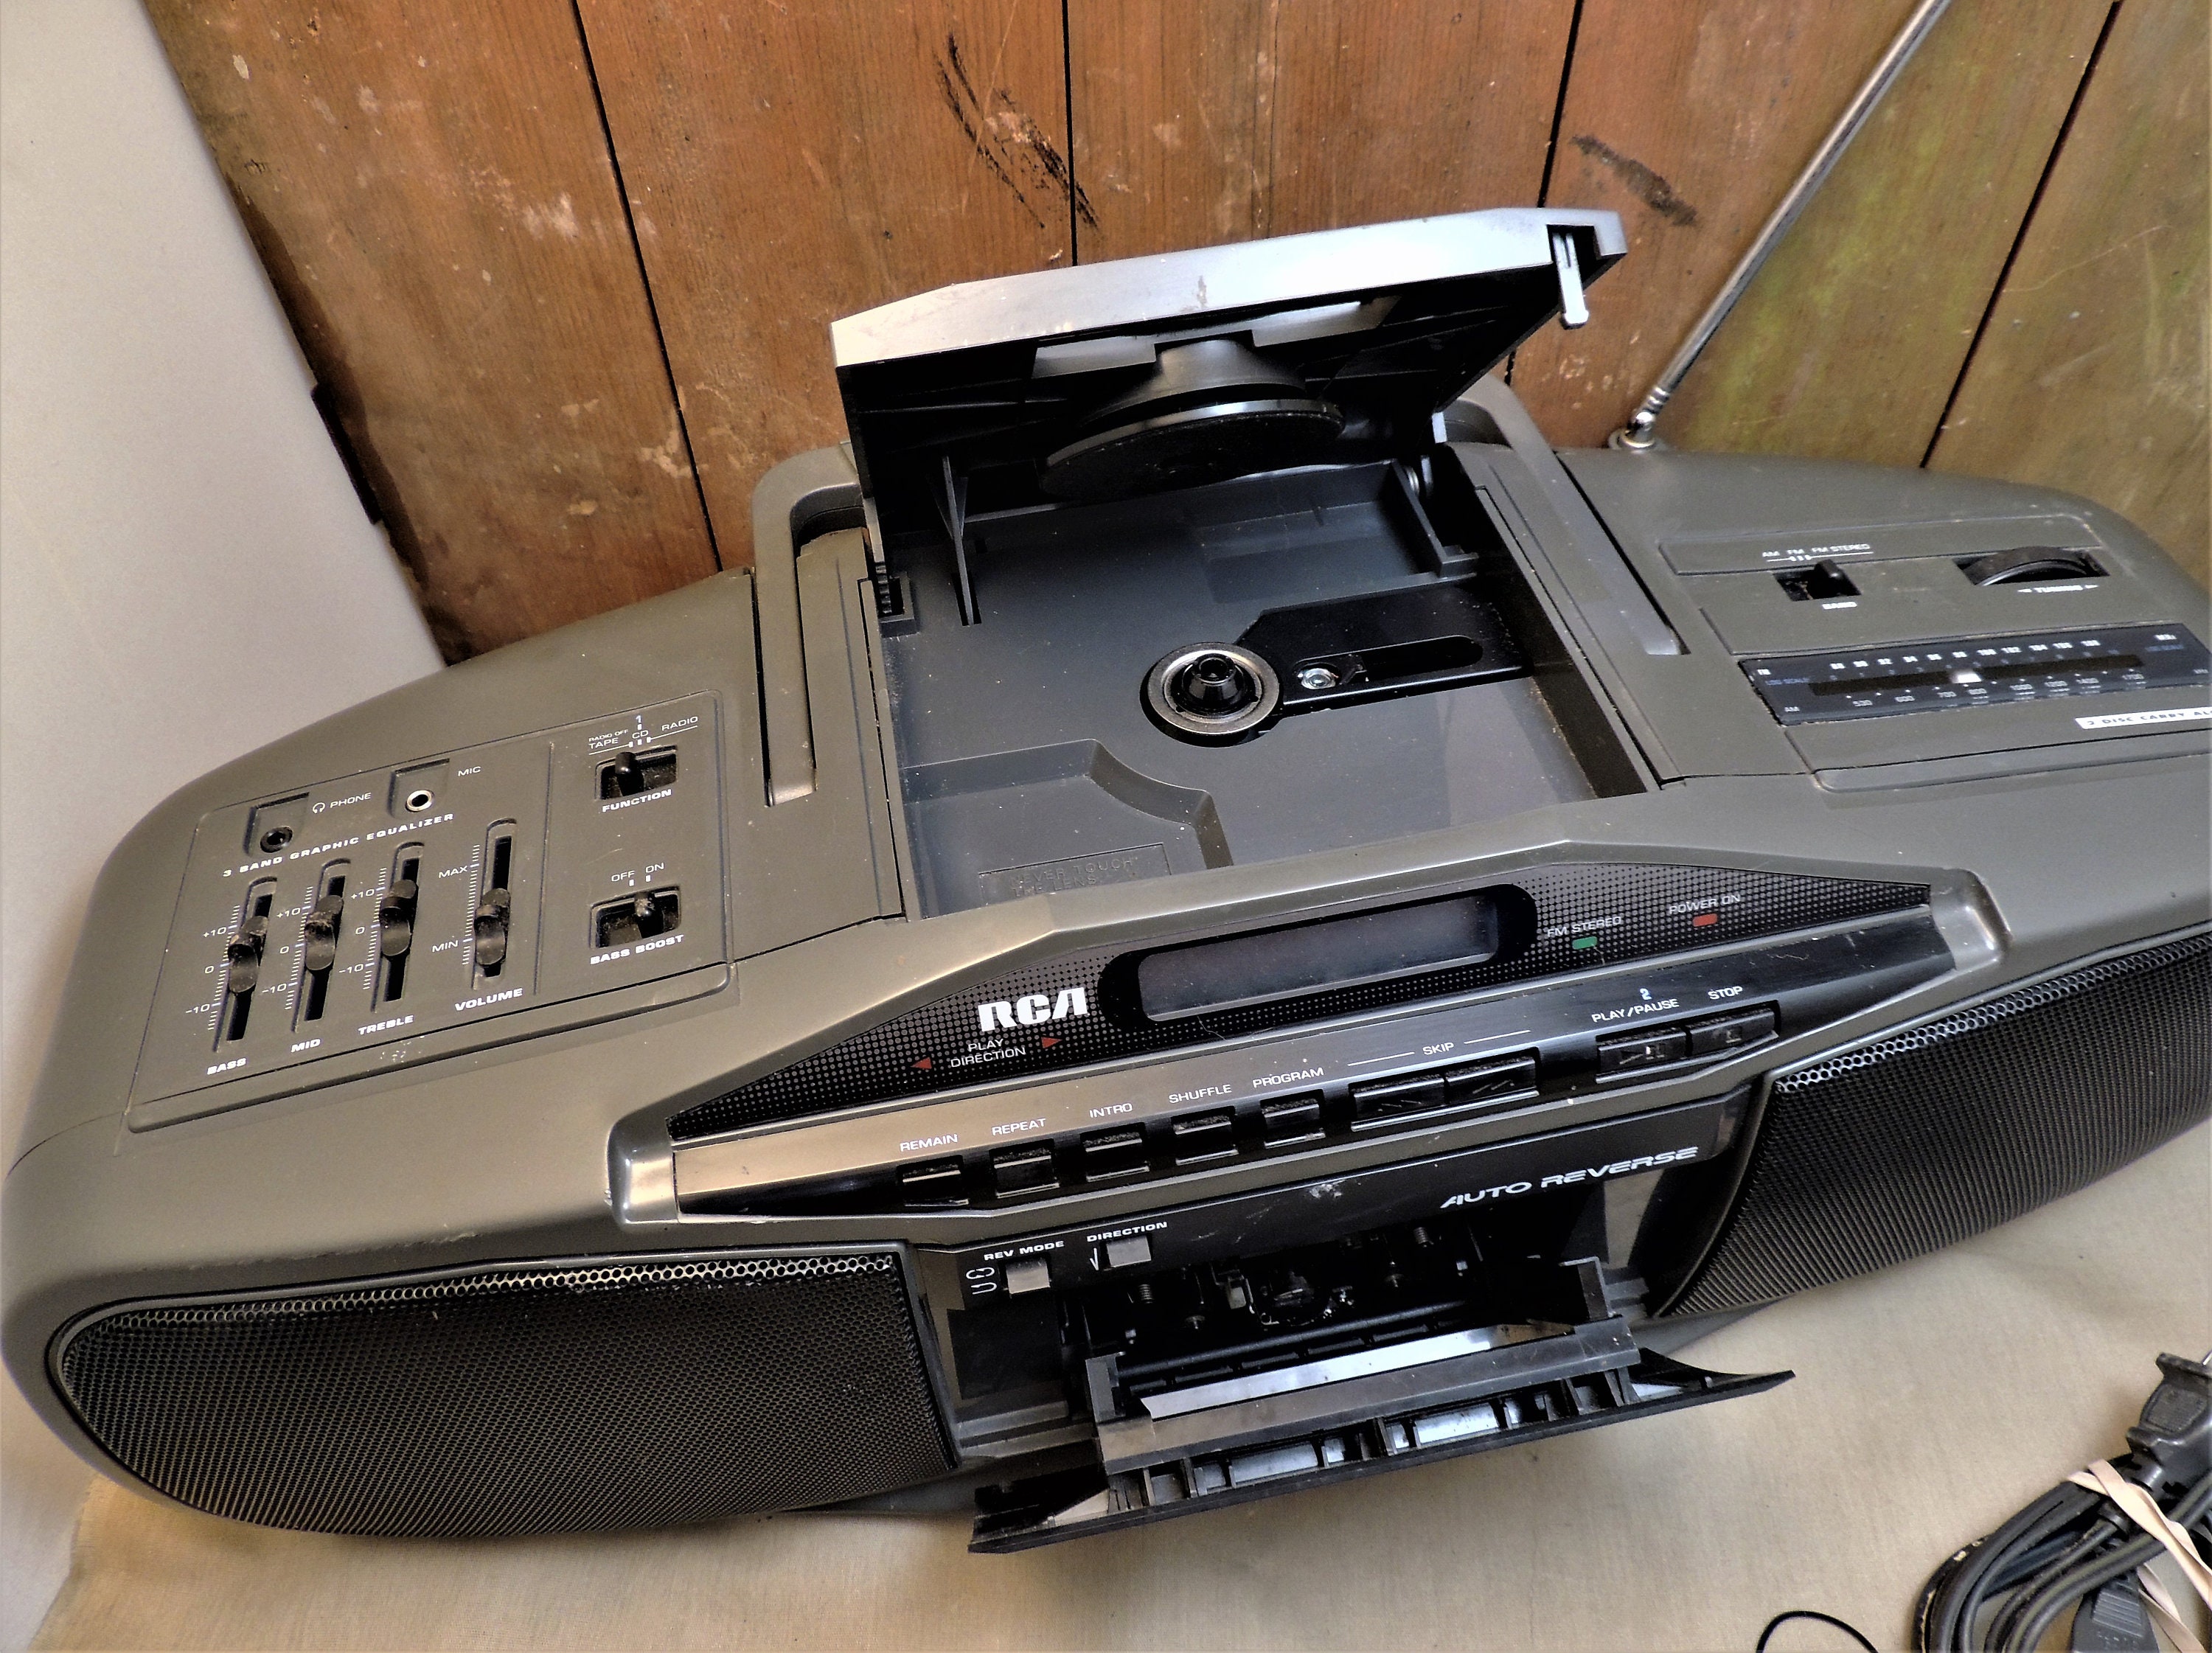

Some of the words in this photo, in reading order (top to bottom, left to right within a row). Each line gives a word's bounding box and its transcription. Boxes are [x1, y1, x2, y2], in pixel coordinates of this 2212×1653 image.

[636, 715, 642, 723] 1
[661, 716, 699, 731] RADIO
[2101, 717, 2134, 725] DISC
[588, 733, 613, 742] RADIO
[632, 729, 649, 740] CD
[588, 737, 619, 750] TAPE
[457, 765, 481, 776] MIC
[330, 792, 372, 809] PHONE
[602, 789, 672, 812] FUNCTION
[223, 869, 233, 877] 3
[239, 856, 283, 874] BAND
[289, 836, 359, 860] GRAPHIC
[366, 812, 455, 841] EQUALIZER
[438, 865, 468, 879] MAX
[611, 870, 636, 883] OFF
[644, 862, 665, 874] ON
[1074, 857, 1133, 875] TOUCH
[351, 888, 375, 899] +10
[276, 907, 301, 919] +10
[1669, 898, 1717, 916] POWER
[1717, 893, 1741, 908] ON
[203, 926, 227, 938] +10
[355, 926, 365, 936] 0
[1547, 925, 1569, 938] FM
[1571, 915, 1622, 933] STEREO
[279, 946, 290, 954] 0
[431, 939, 459, 953] MIN
[590, 948, 630, 965] BASS
[635, 934, 684, 954] BOOST
[204, 964, 215, 974] 0
[338, 964, 364, 974] -10
[261, 983, 287, 994] -10
[1639, 987, 1652, 1000] 2
[1707, 985, 1744, 1000] STOP
[184, 1003, 210, 1013] -10
[454, 987, 524, 1012] VOLUME
[977, 986, 1090, 1032] RCA
[1590, 998, 1680, 1023] PLAY/PAUSE
[358, 1015, 414, 1036] TREBLE
[291, 1038, 321, 1053] MID
[967, 1038, 1005, 1054] PLAY
[1422, 1040, 1455, 1057] SKIP
[950, 1046, 1026, 1069] DIRECTION
[206, 1057, 246, 1076] BASS
[1252, 1067, 1324, 1089] PROGRAM
[1168, 1084, 1232, 1104] SHUFFLE
[1089, 1102, 1134, 1119] INTRO
[992, 1118, 1046, 1137] REPEAT
[900, 1133, 959, 1152] REMAIN
[1440, 1181, 1534, 1210] AUTO
[1540, 1146, 1699, 1189] REVERSE
[1086, 1221, 1168, 1243] DIRECTION
[983, 1249, 1015, 1262] REV
[1019, 1240, 1065, 1255] MODE
